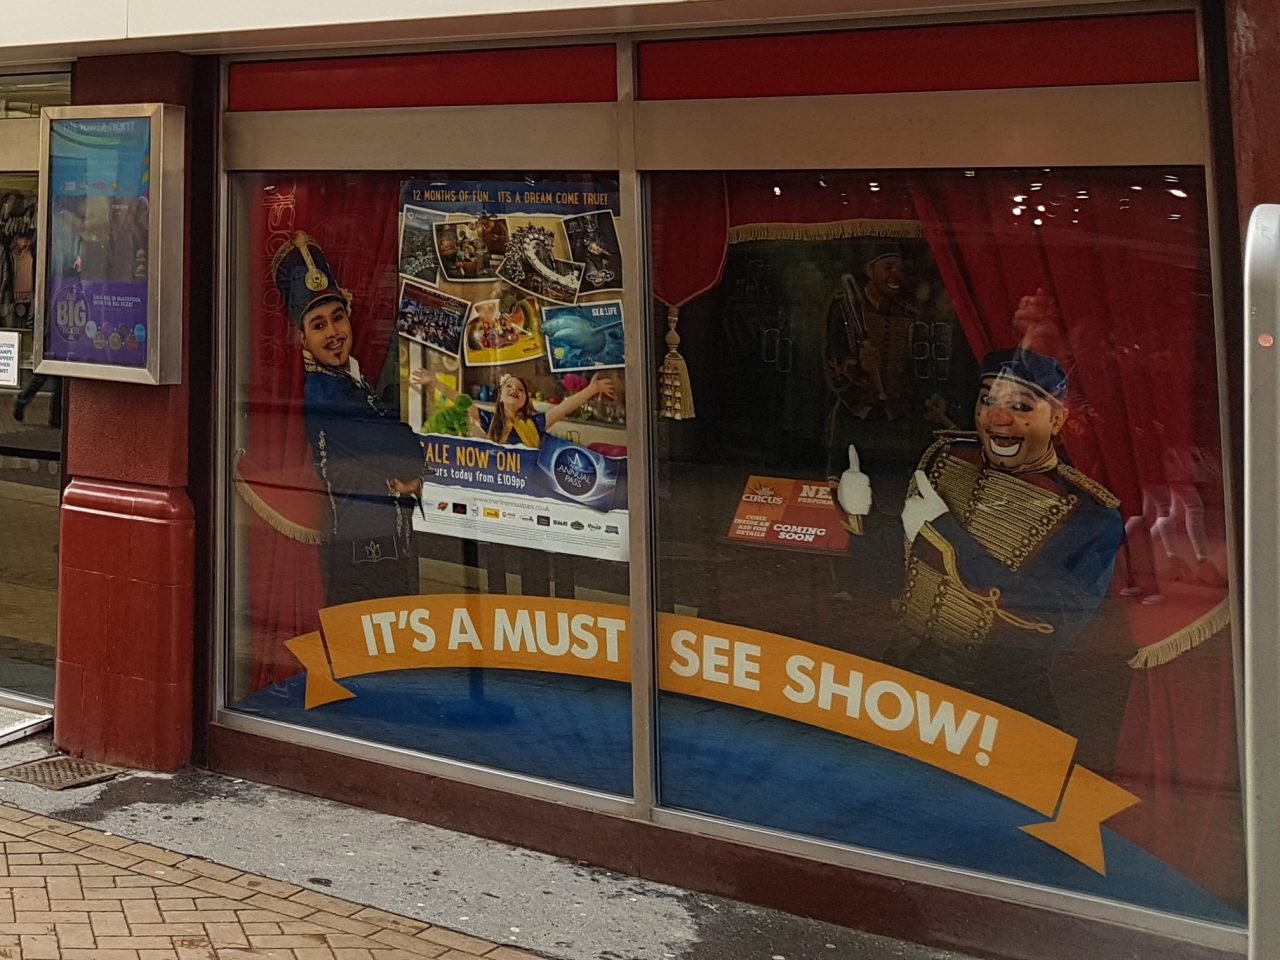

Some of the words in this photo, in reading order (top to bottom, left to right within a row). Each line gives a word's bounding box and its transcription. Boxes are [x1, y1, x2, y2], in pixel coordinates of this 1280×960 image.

[412, 189, 421, 201] 12
[424, 190, 456, 202] MONTHS
[458, 190, 469, 202] OF
[515, 192, 521, 204] A
[524, 192, 552, 205] DREAM
[555, 192, 579, 205] COME
[583, 193, 608, 206] TRUE!
[57, 299, 87, 327] BIG
[422, 441, 450, 465] ALE
[456, 446, 490, 469] NOW
[496, 451, 521, 473] ON!
[451, 468, 473, 482] today
[475, 470, 494, 483] from
[556, 464, 591, 484] ANNUAL
[564, 474, 582, 488] PASS
[742, 494, 783, 504] CIRCUS
[772, 523, 826, 536] COMING
[777, 531, 816, 542] SOON
[360, 607, 436, 656] IT'S
[448, 612, 483, 651] A
[492, 607, 627, 663] MUST
[669, 629, 762, 692] SEE
[781, 654, 999, 768] SHOW!
